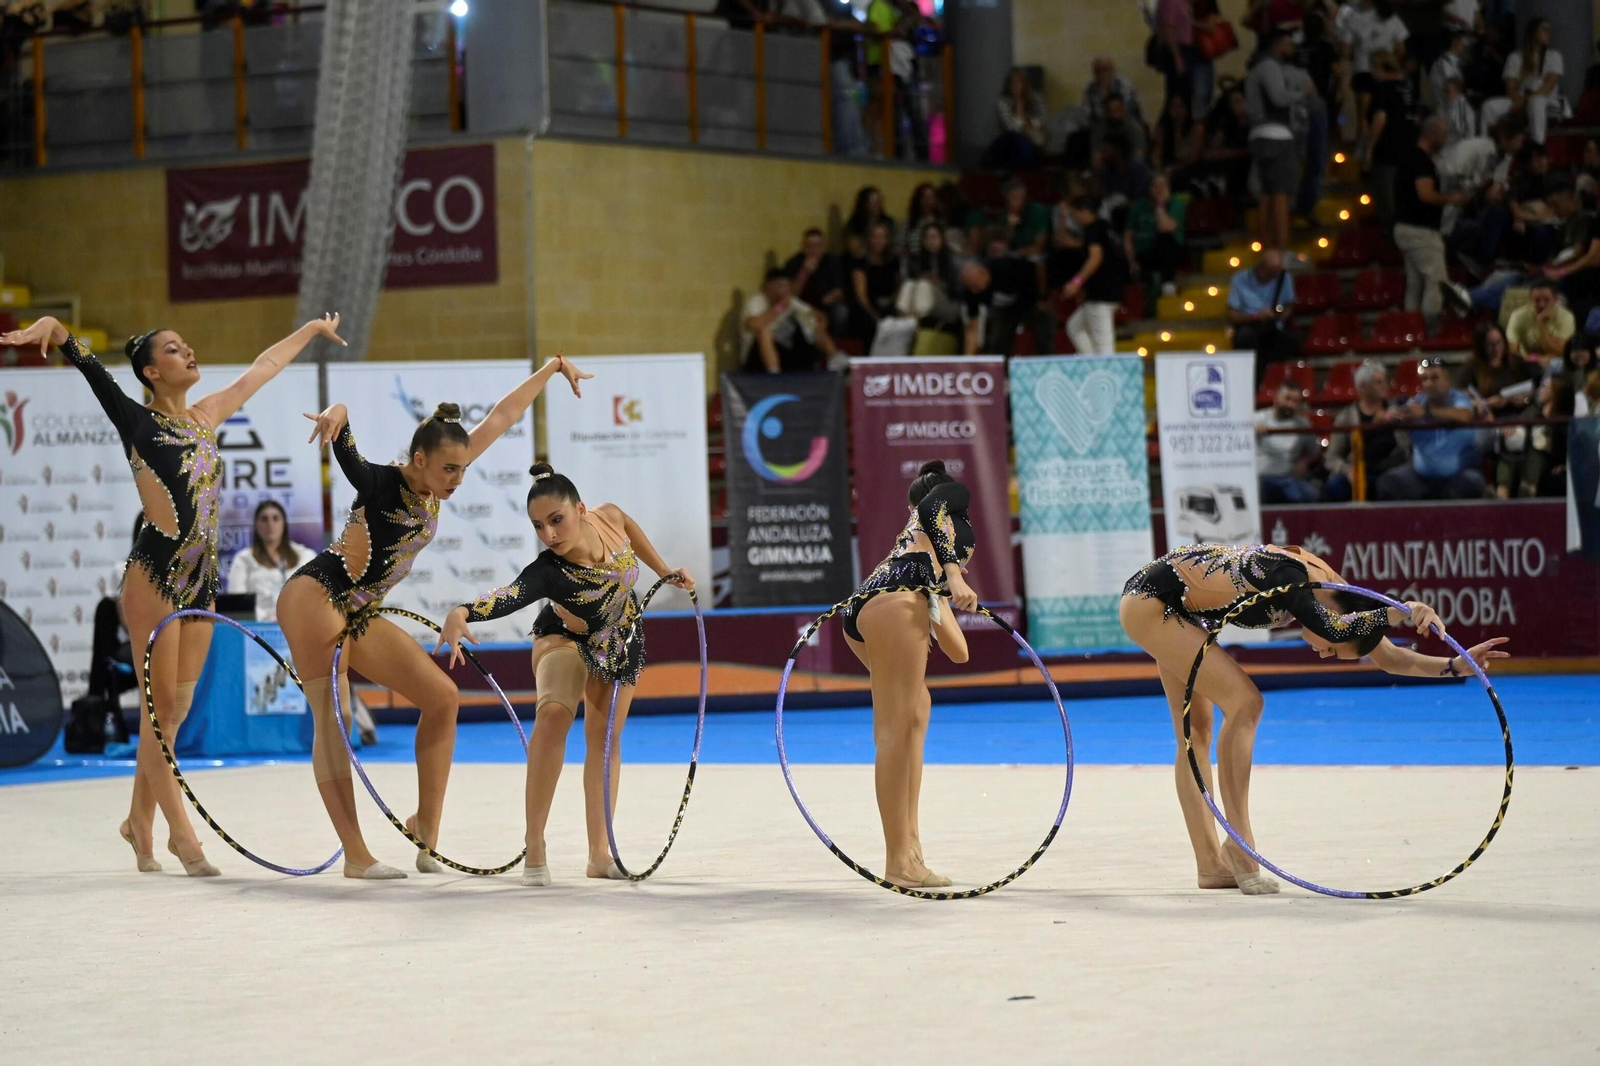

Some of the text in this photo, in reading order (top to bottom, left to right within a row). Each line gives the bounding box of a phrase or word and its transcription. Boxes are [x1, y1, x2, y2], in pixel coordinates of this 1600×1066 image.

[249, 175, 485, 248] IMCO
[893, 372, 994, 396] IMDECO
[33, 431, 121, 446] ALMANZO
[905, 420, 976, 438] IMDECO
[747, 502, 830, 523] FEDERACIÓN
[746, 523, 834, 543] ANDALUZA
[747, 544, 834, 566] GIMNASIA
[1341, 537, 1546, 581] AYUNTAMIENTO
